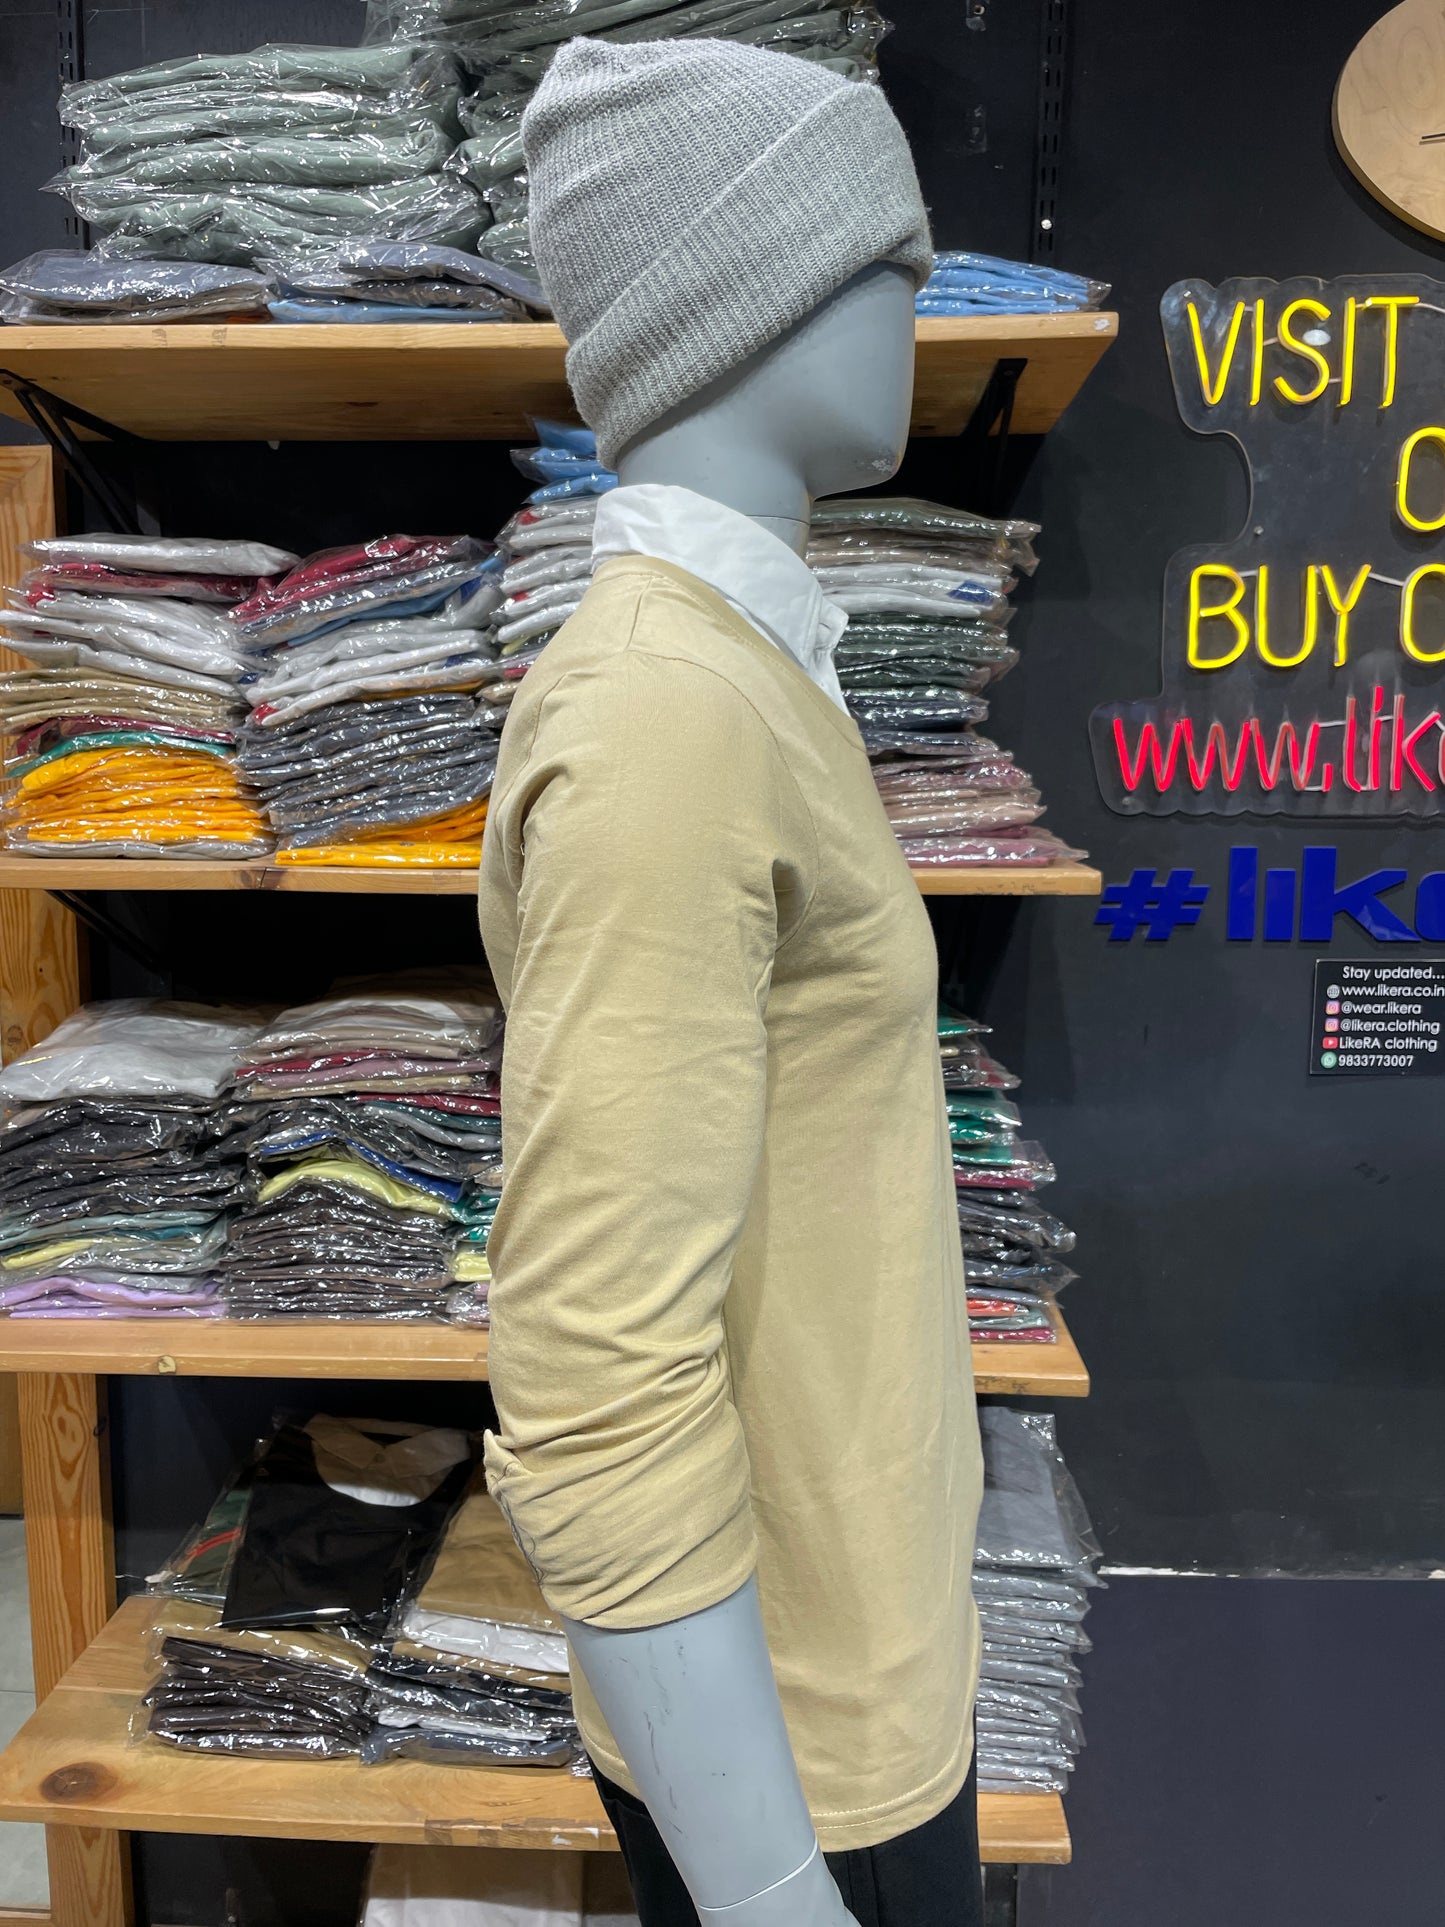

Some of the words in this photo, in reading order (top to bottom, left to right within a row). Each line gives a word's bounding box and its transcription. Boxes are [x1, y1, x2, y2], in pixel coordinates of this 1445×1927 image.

[1186, 296, 1420, 408] VISIT
[1187, 563, 1372, 669] BUY
[1111, 685, 1445, 793] www.lik
[1342, 965, 1371, 981] Stay
[1374, 965, 1445, 981] updated...
[1341, 984, 1445, 998] www.likera.co.in
[1341, 1001, 1422, 1014] @wear.likera
[1340, 1018, 1441, 1035] @likera.clothing
[1339, 1036, 1381, 1050] LikeRA
[1384, 1036, 1438, 1052] clothing
[1338, 1054, 1414, 1067] 9833773007
